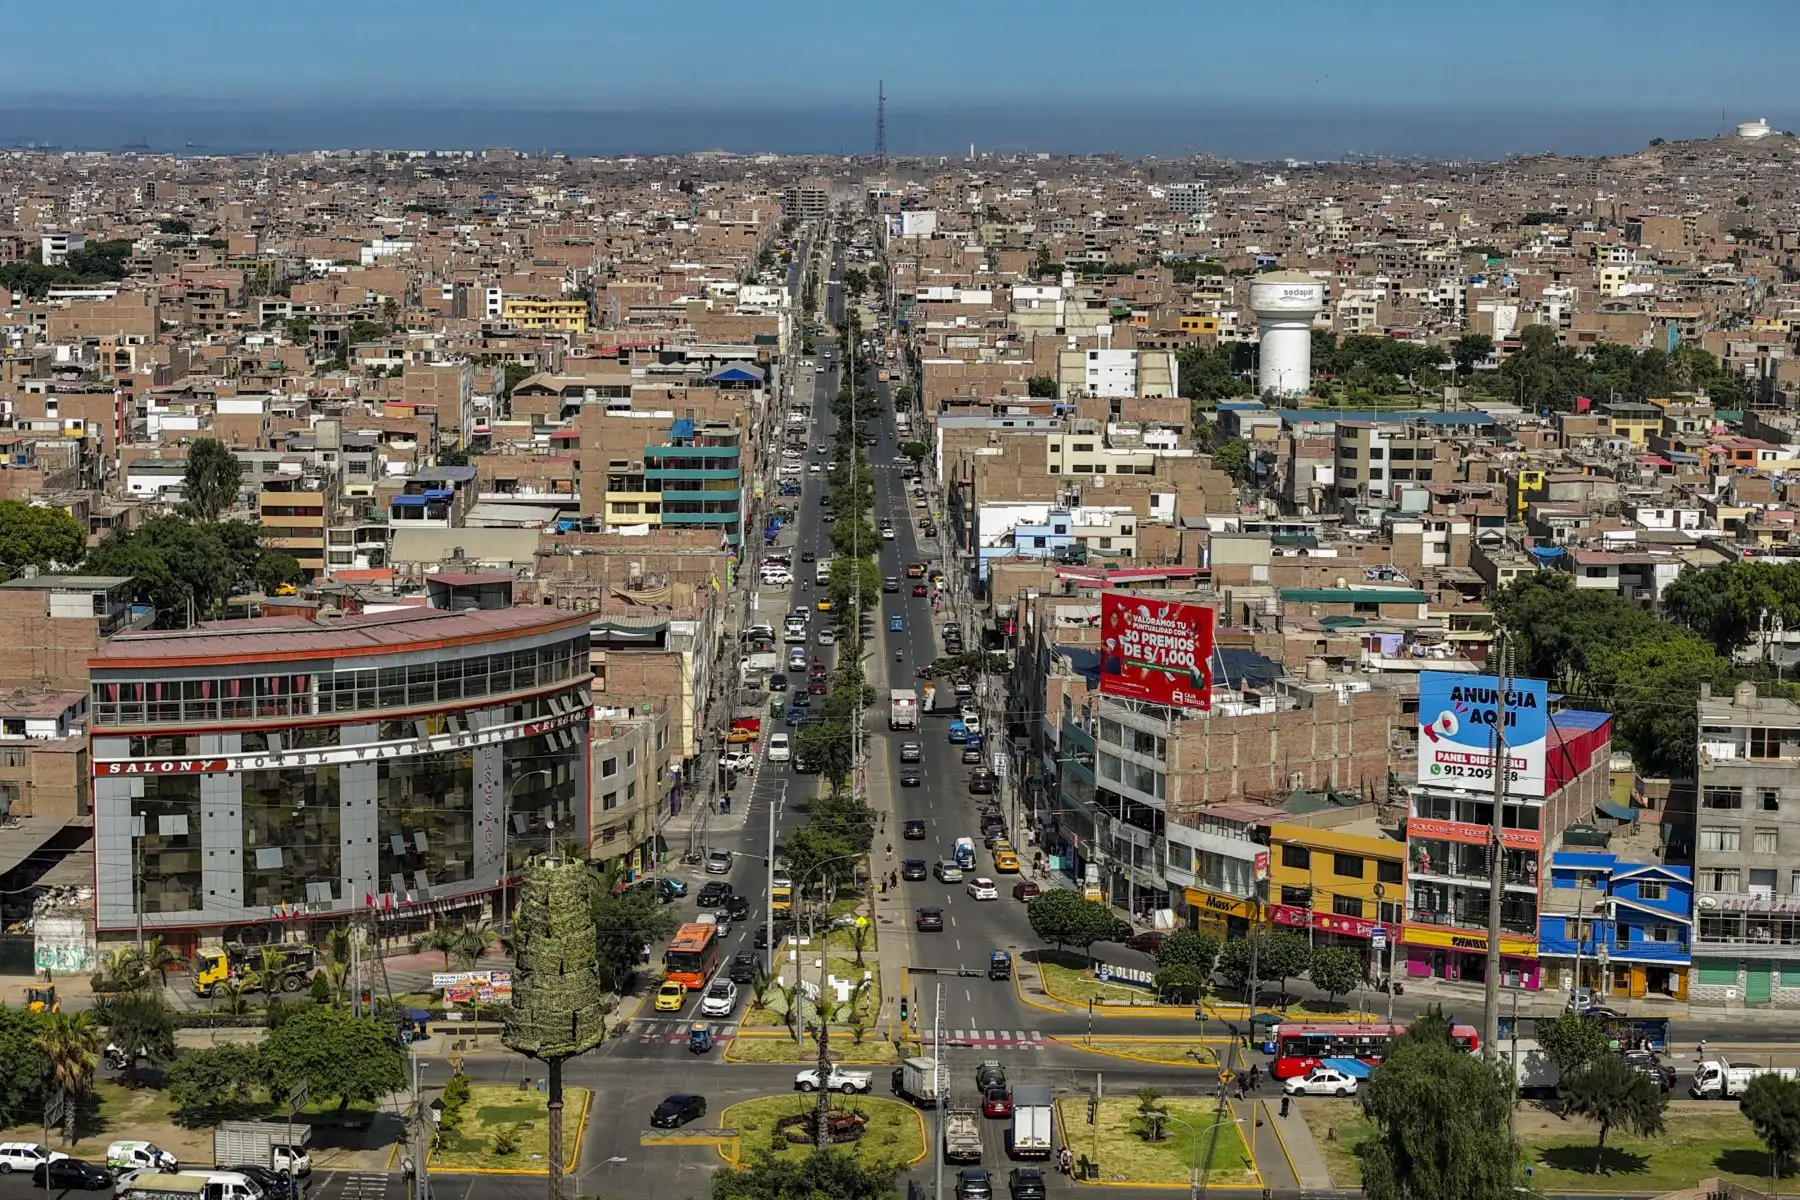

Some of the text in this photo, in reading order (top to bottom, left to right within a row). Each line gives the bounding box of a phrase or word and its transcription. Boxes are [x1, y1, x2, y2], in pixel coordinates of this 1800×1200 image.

[1284, 288, 1313, 297] sedapal
[1133, 615, 1187, 629] VALORAMOS TU
[1133, 622, 1187, 637] PUNTUALIDAD CON
[1124, 629, 1195, 652] 30 PREMIOS
[1124, 642, 1142, 658] DE
[1450, 686, 1537, 708] ANUNCIA
[109, 761, 193, 773] SALON
[235, 753, 328, 769] HOTEL
[355, 742, 435, 759] WAYRA
[1437, 751, 1467, 763] PANEL
[1444, 765, 1464, 776] 912
[1468, 767, 1492, 779] 209
[1206, 895, 1230, 911] Mass
[1117, 966, 1152, 983] OLIVOS
